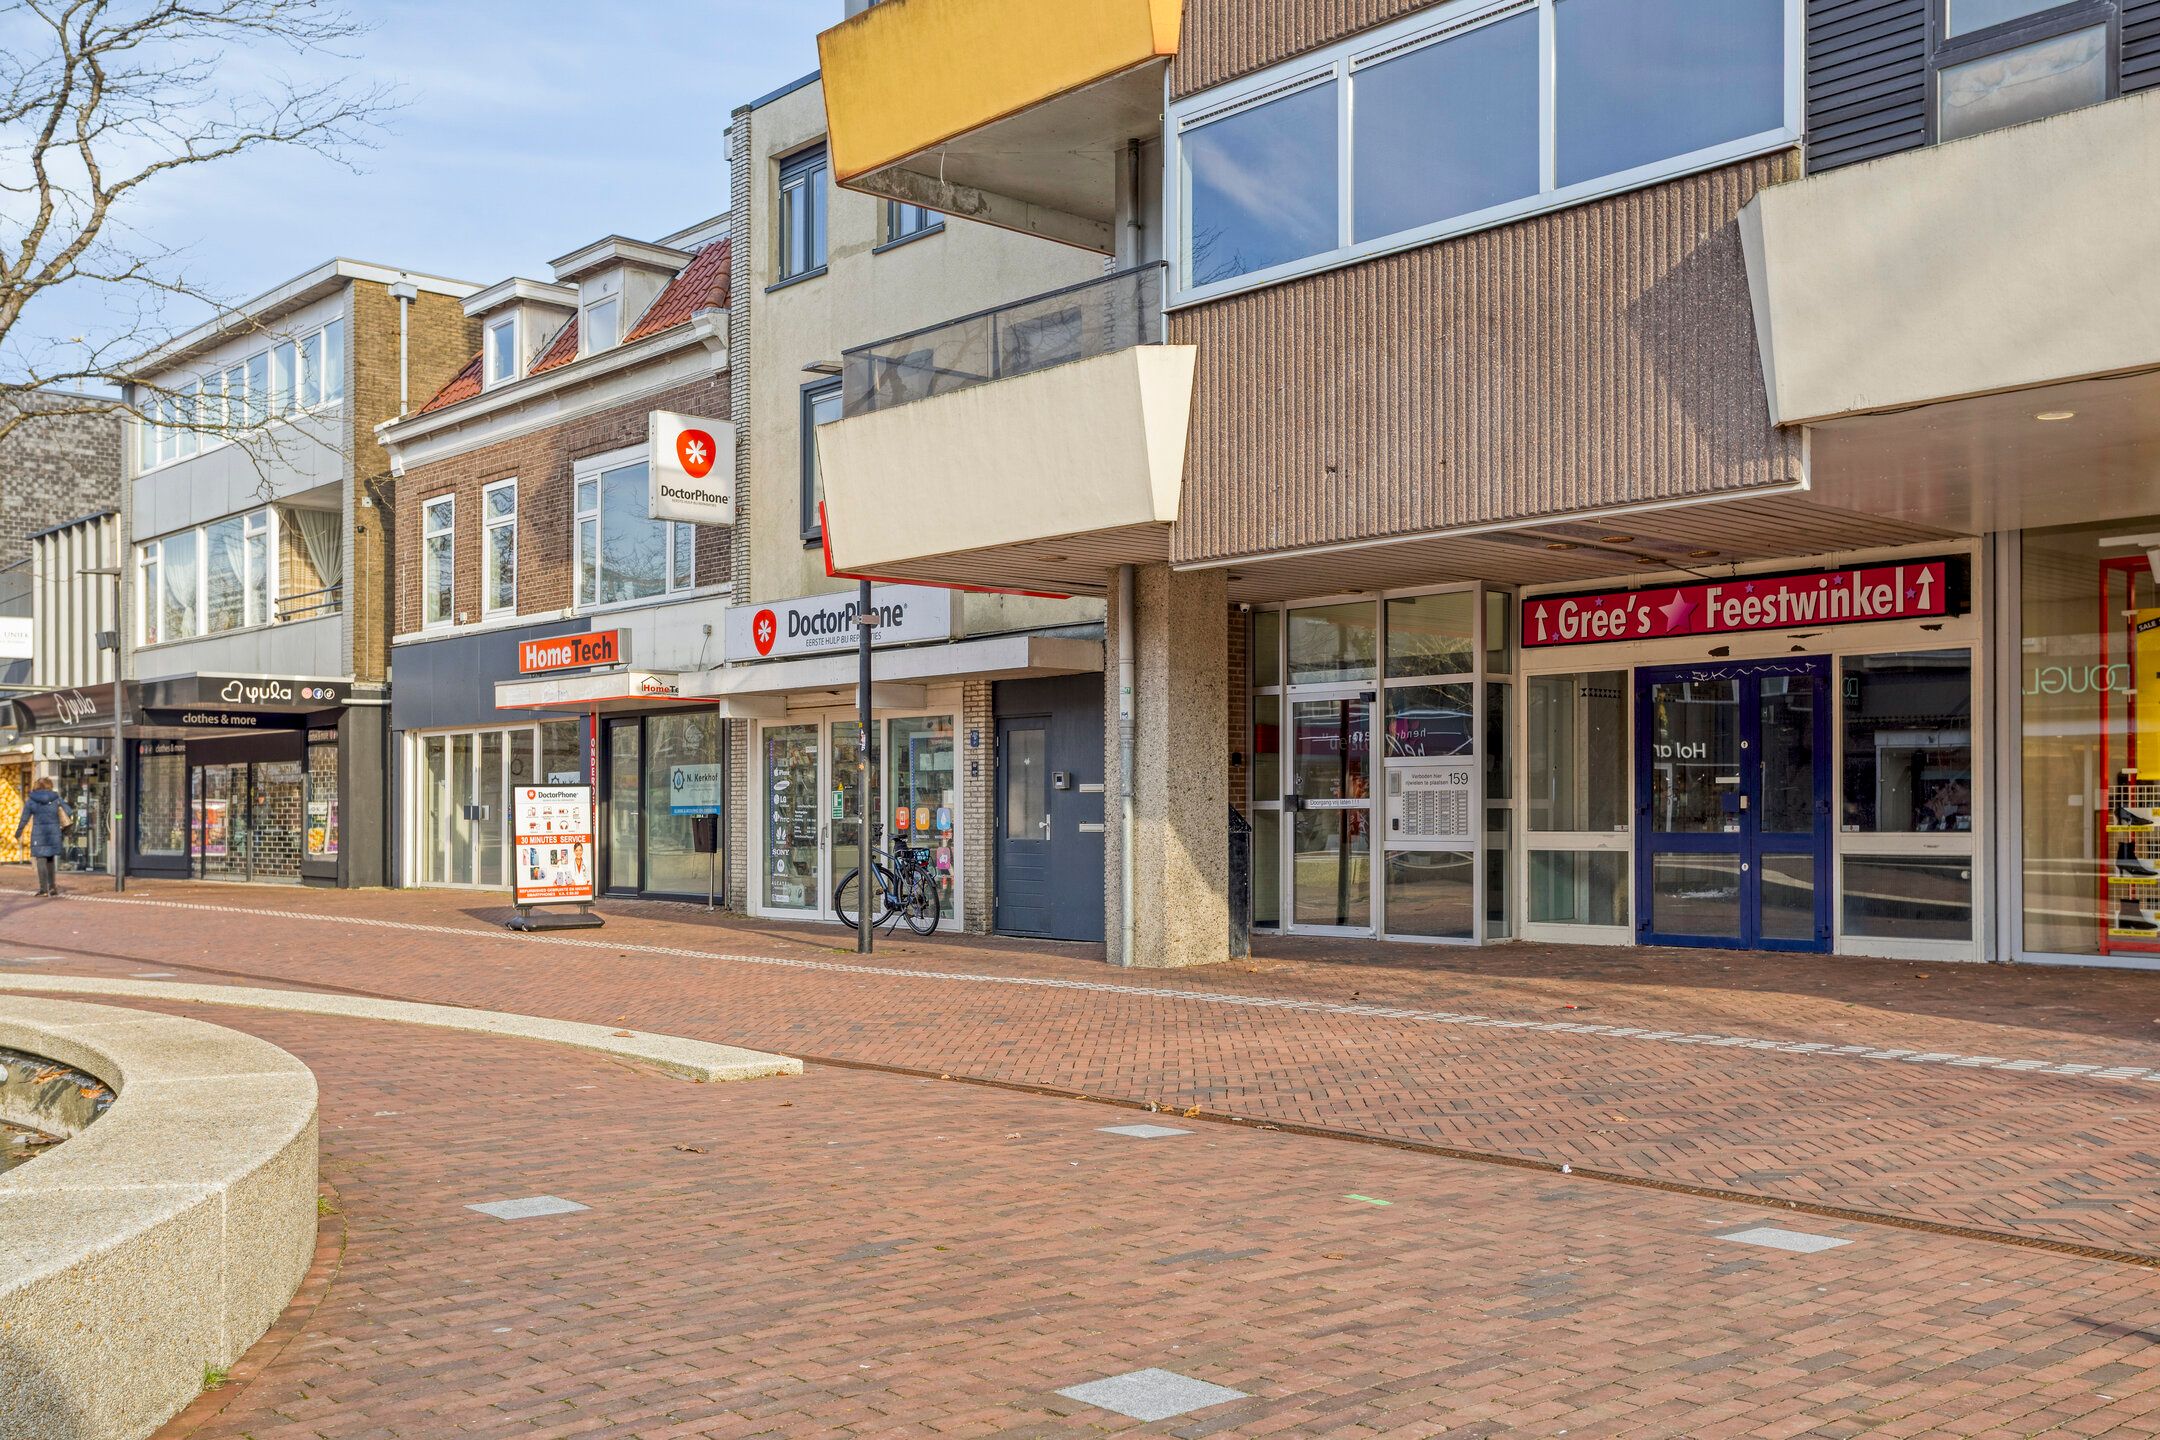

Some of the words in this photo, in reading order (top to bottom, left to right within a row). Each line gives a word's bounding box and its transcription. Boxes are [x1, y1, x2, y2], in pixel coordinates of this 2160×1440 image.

[661, 485, 728, 504] DoctorPhone
[1558, 596, 1651, 640] Gree's
[1707, 567, 1904, 628] Feestwinkel
[2138, 620, 2157, 631] SALE
[805, 637, 825, 647] EERSTE
[825, 635, 840, 645] HULP
[525, 635, 612, 669] HomeTech
[182, 713, 219, 724] clothes
[220, 714, 229, 724] &
[230, 716, 257, 725] more
[695, 773, 718, 782] Kerkhof
[1448, 772, 1469, 785] 159
[538, 791, 577, 799] DoctorPhone
[530, 836, 557, 844] MINUTES
[560, 835, 586, 843] SERVICE
